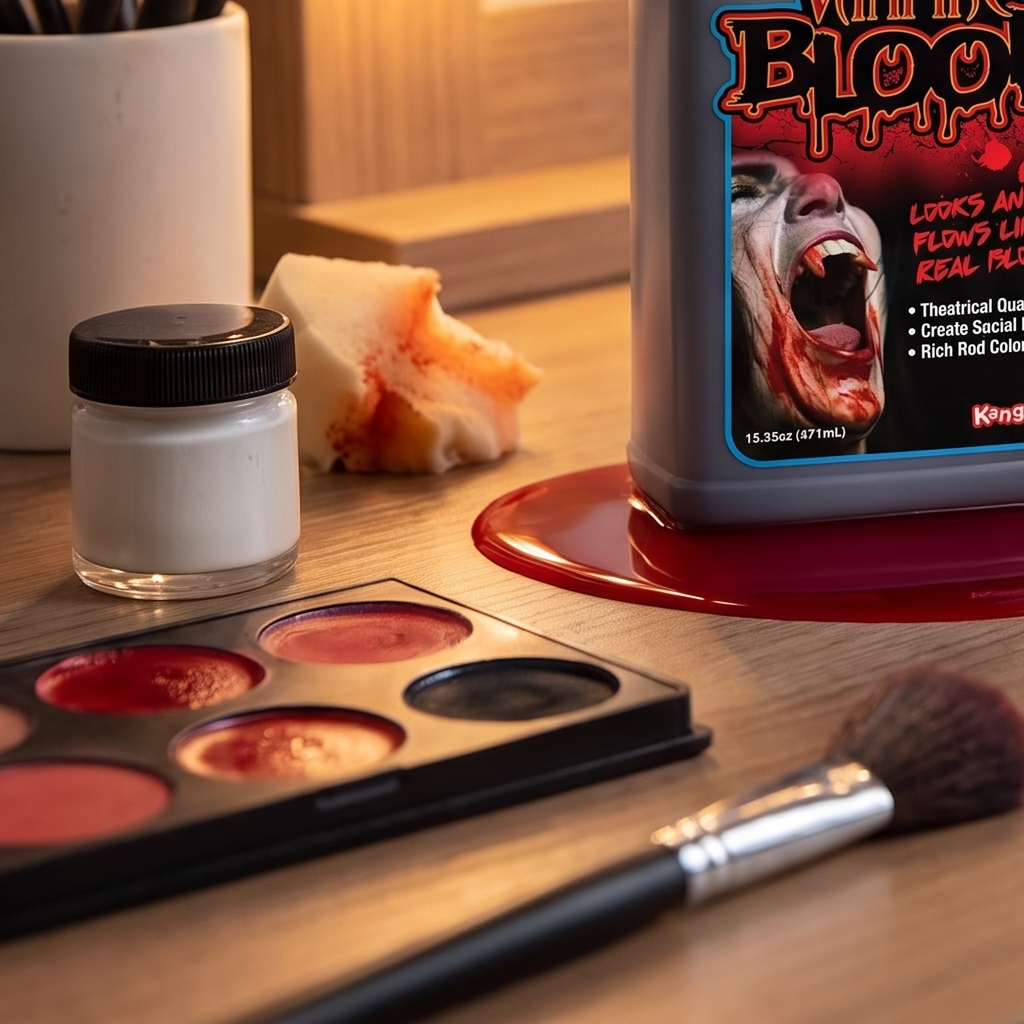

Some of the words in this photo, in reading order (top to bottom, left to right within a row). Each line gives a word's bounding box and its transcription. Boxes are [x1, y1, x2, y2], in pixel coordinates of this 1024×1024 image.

[909, 192, 985, 225] LOOKS
[913, 220, 992, 256] FLOWS
[916, 254, 980, 285] REAL
[920, 298, 992, 317] Theatrical
[920, 321, 969, 338] Create
[921, 342, 953, 358] Rich
[745, 431, 793, 444] 15.35oz
